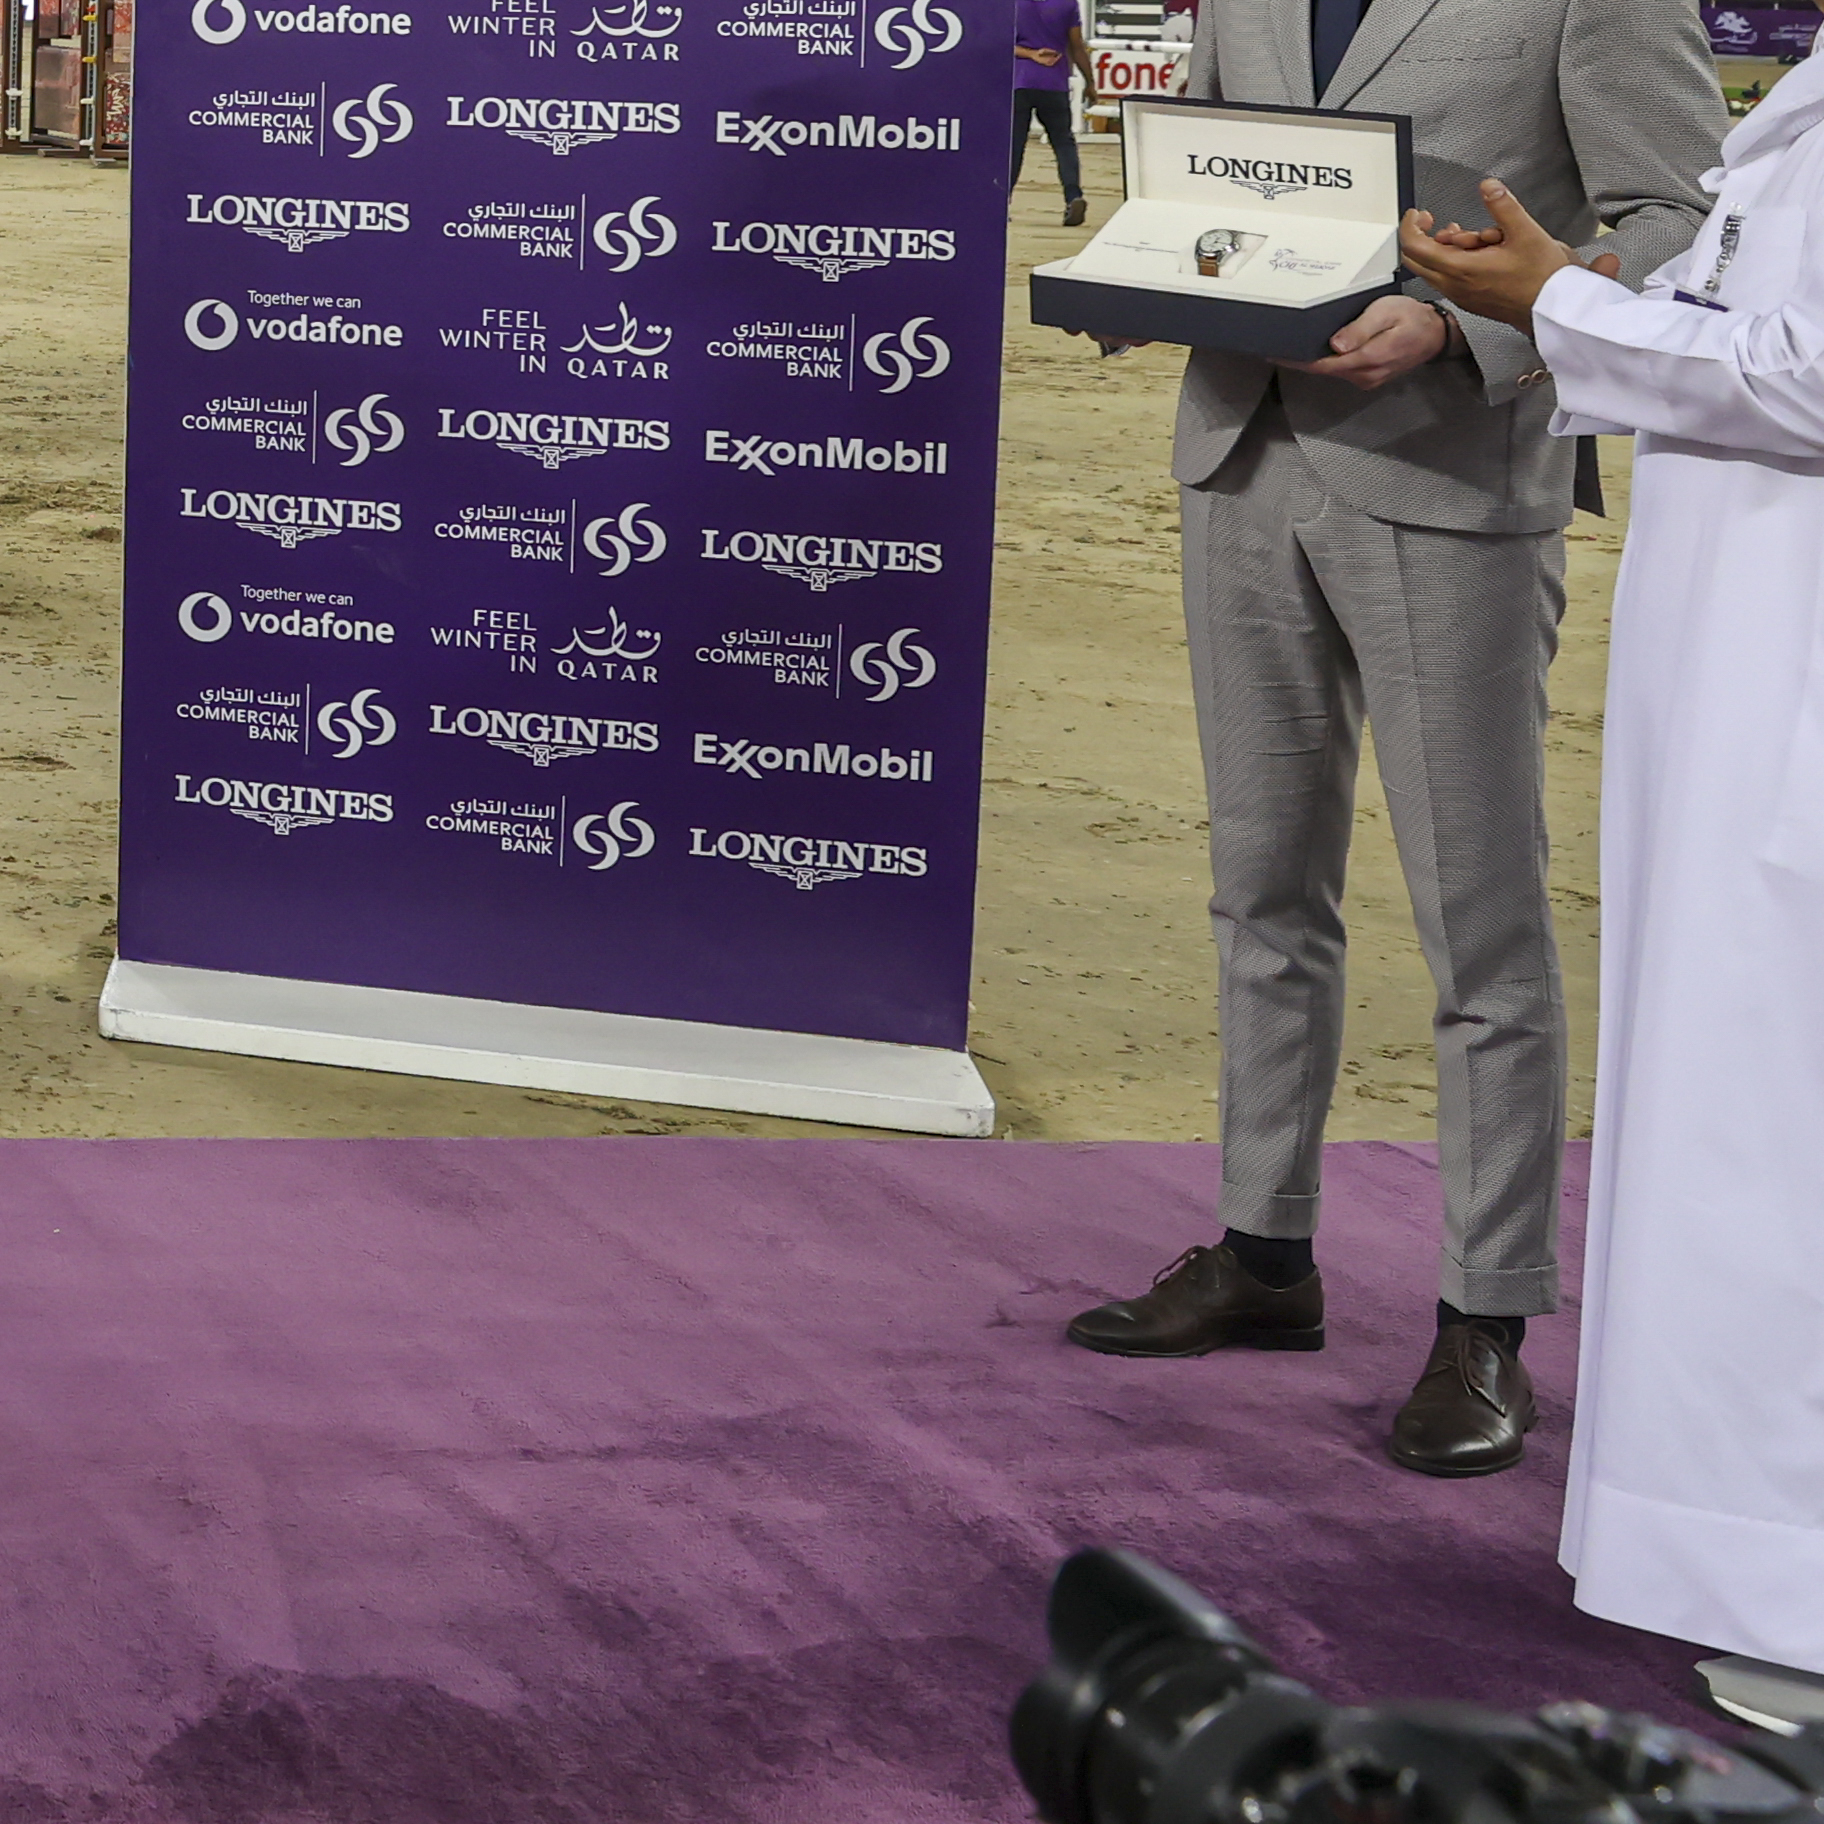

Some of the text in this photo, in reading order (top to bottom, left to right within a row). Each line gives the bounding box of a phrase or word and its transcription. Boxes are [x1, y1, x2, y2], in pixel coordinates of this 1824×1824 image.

[254, 5, 411, 35] vodafone
[749, 0, 856, 19] البنك التجاري
[448, 16, 555, 36] WINTER
[717, 21, 854, 38] COMMERCIAL
[530, 40, 555, 57] IN
[577, 41, 679, 62] QATAR
[798, 39, 853, 55] BANK
[1096, 52, 1175, 90] fone
[1187, 154, 1353, 189] LONGINES
[200, 687, 300, 709] البنك التجاري
[177, 704, 299, 727] COMMERCIAL
[249, 725, 298, 743] BANK
[429, 705, 659, 752] LONGINES
[694, 733, 933, 782] ExxonMobil
